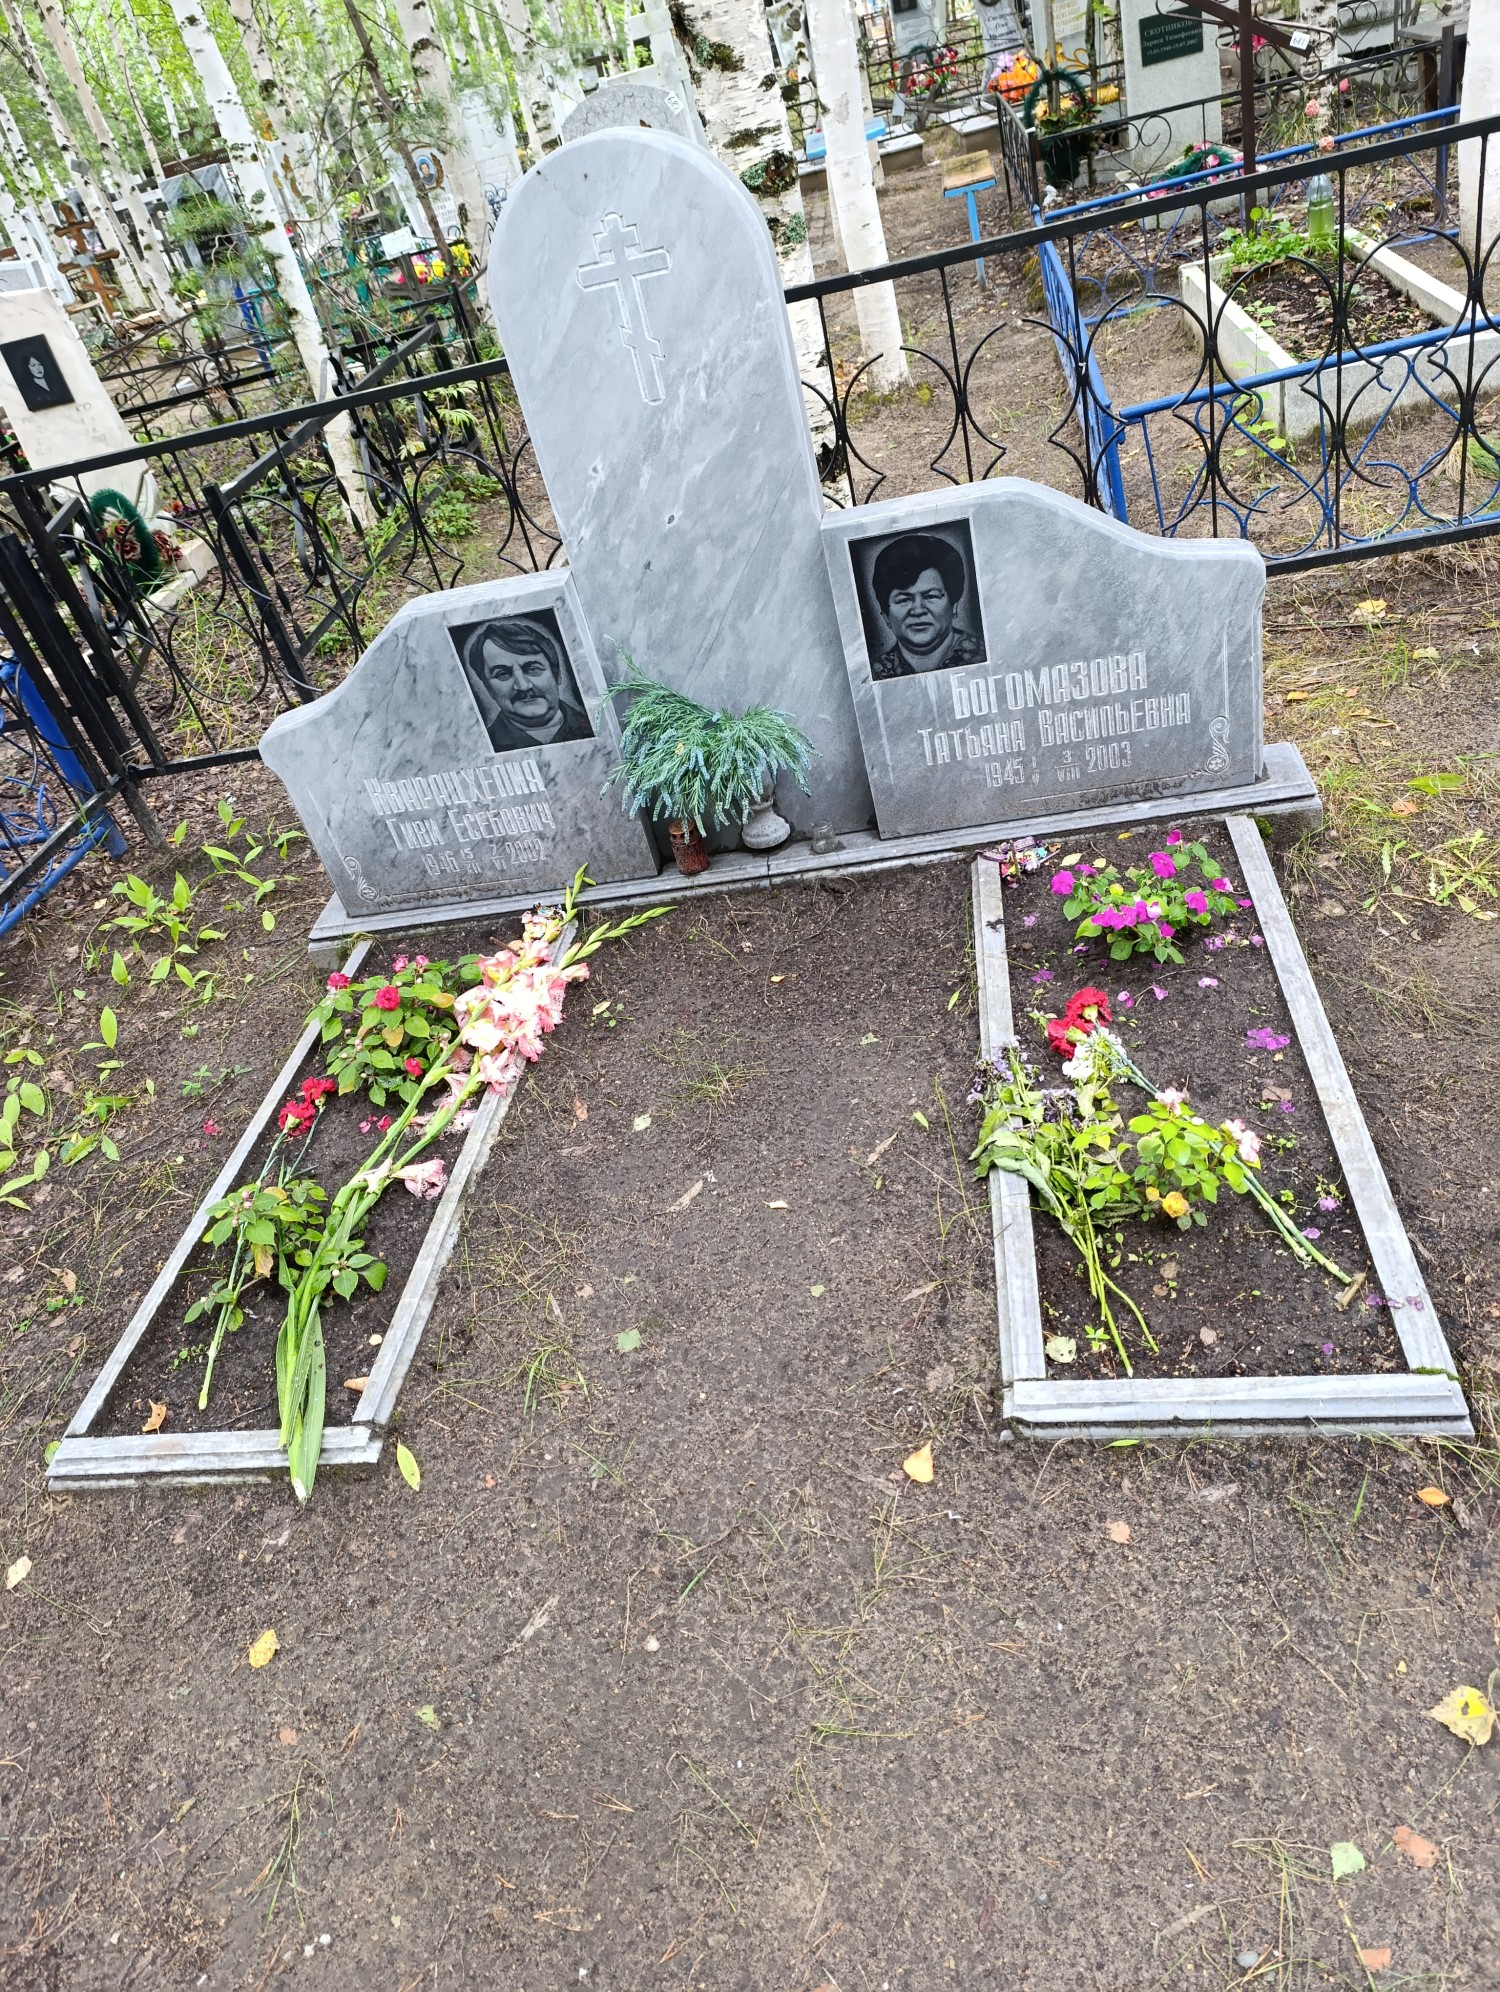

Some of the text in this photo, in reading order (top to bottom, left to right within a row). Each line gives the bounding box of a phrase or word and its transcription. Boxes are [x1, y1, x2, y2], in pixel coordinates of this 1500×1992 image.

[1144, 19, 1199, 37] СКОТНИКОВ
[984, 757, 1025, 788] 1945
[1085, 741, 1132, 773] 2003
[420, 850, 460, 876] 1946
[505, 838, 547, 865] 2002
